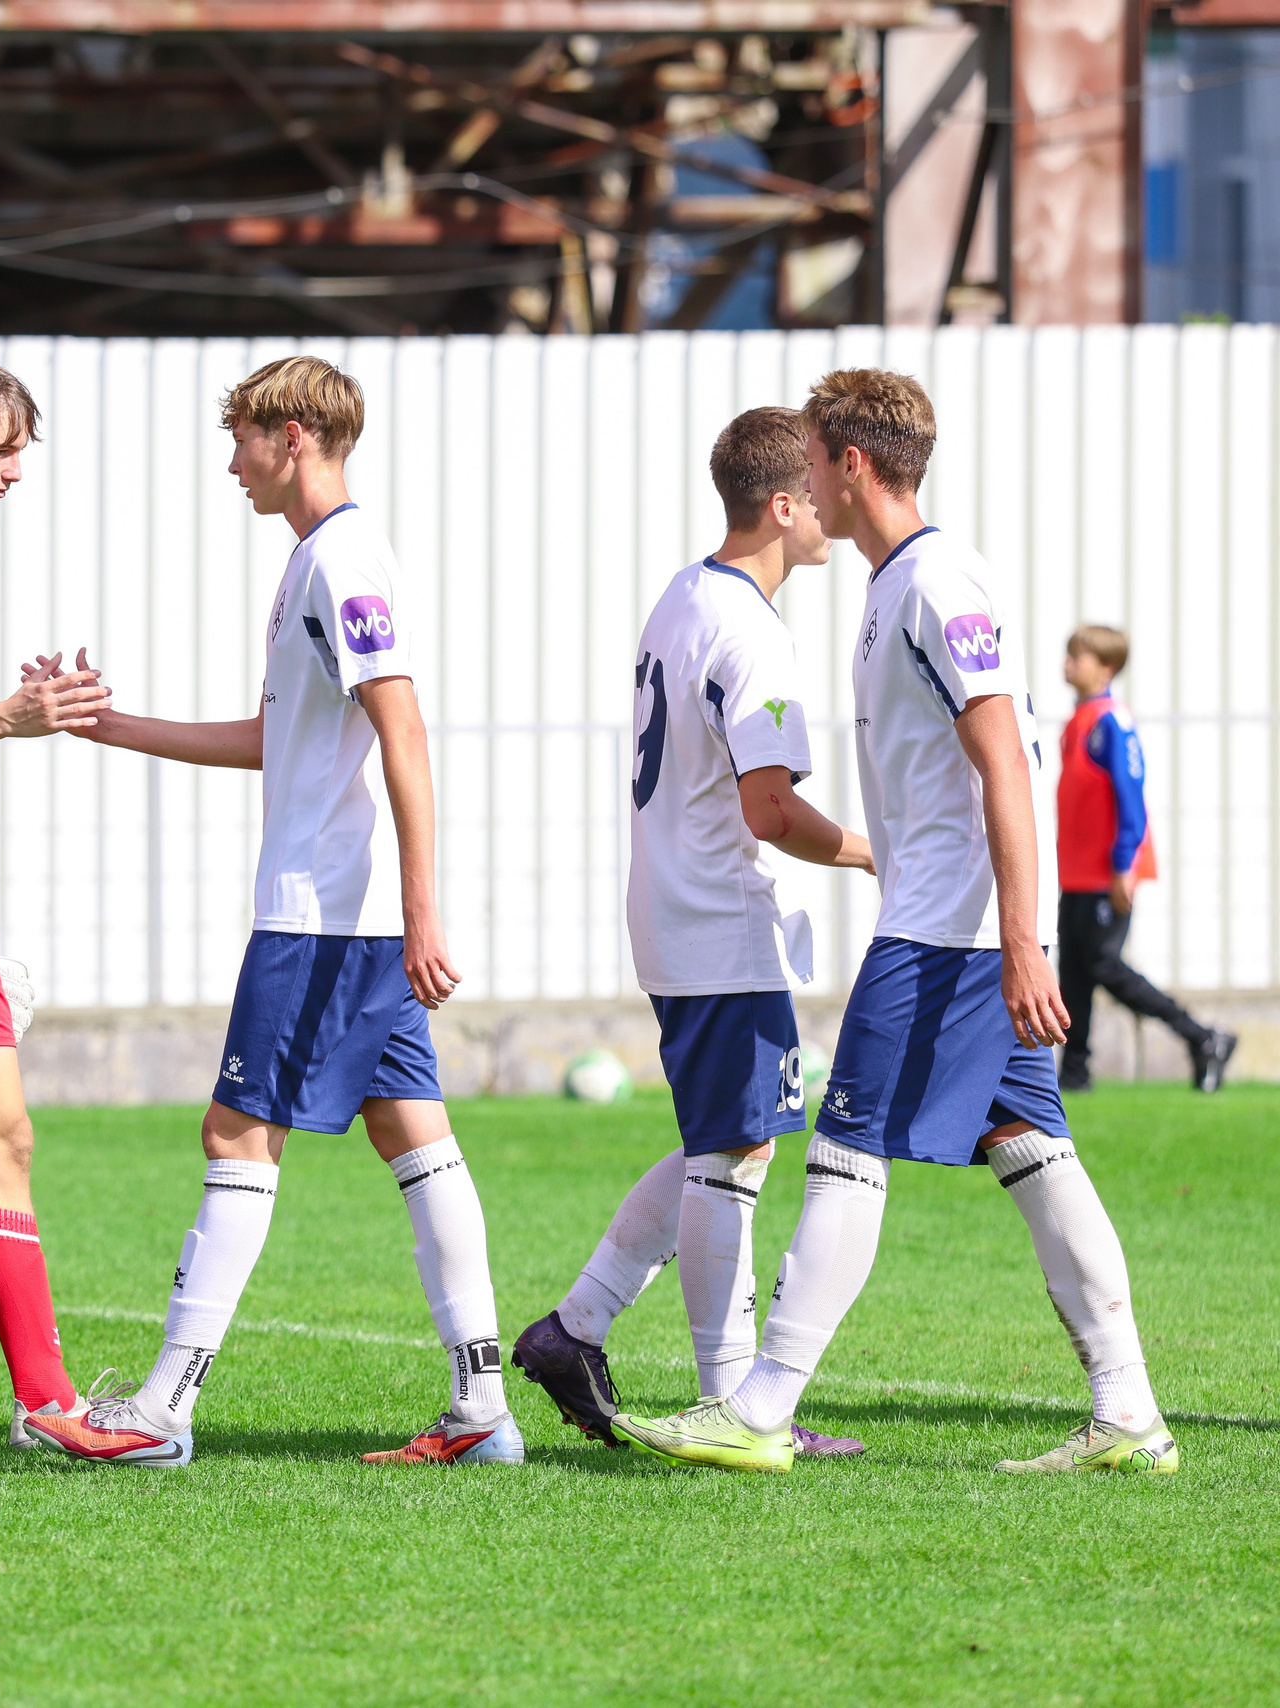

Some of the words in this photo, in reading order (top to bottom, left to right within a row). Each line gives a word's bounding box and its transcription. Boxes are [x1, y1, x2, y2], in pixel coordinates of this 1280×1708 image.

[345, 607, 391, 639] wb
[950, 626, 997, 658] wb
[222, 1070, 245, 1083] KELME
[827, 1103, 852, 1118] KELME
[1046, 1151, 1078, 1165] KEL
[684, 1175, 703, 1185] ME
[860, 1176, 888, 1192] KEL
